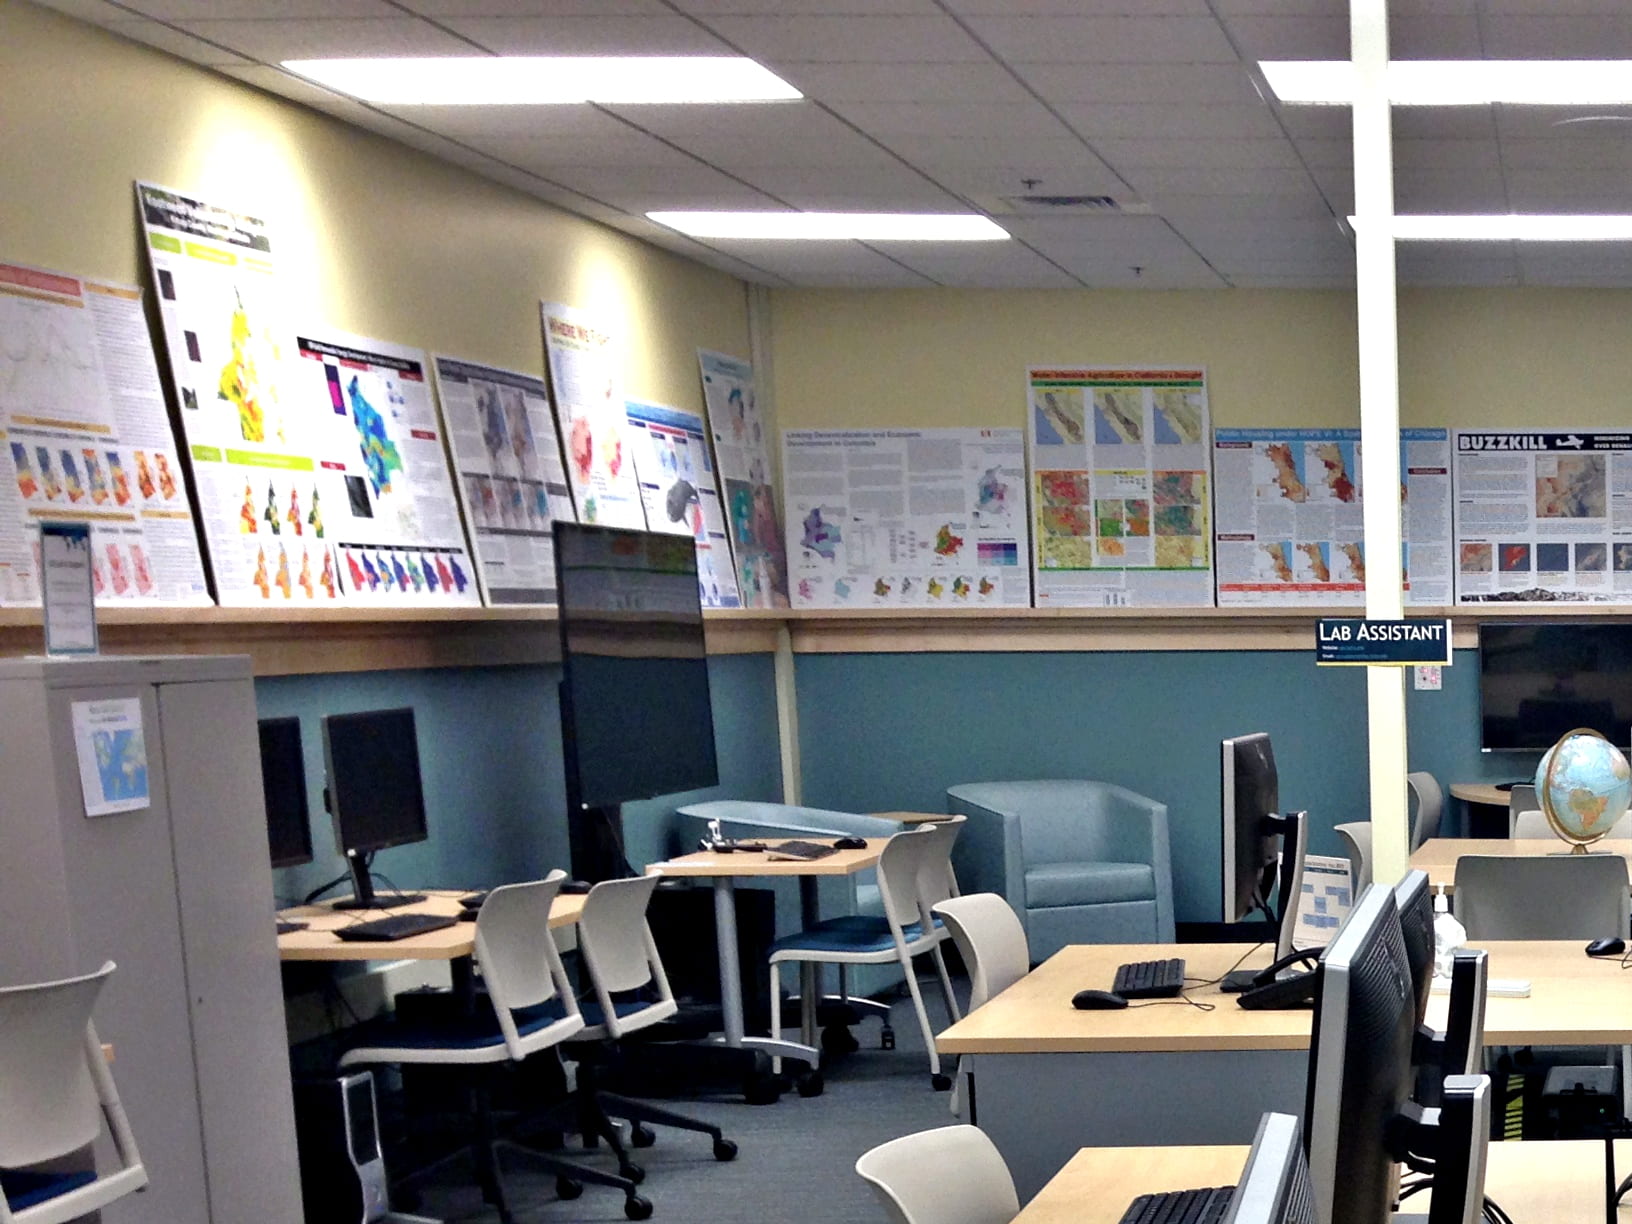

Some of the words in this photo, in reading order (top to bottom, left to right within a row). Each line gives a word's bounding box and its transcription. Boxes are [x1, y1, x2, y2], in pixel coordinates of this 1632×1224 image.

[1459, 436, 1548, 450] BUZZKILL
[1319, 622, 1352, 641] LAB
[1356, 622, 1444, 641] ASSISTANT
